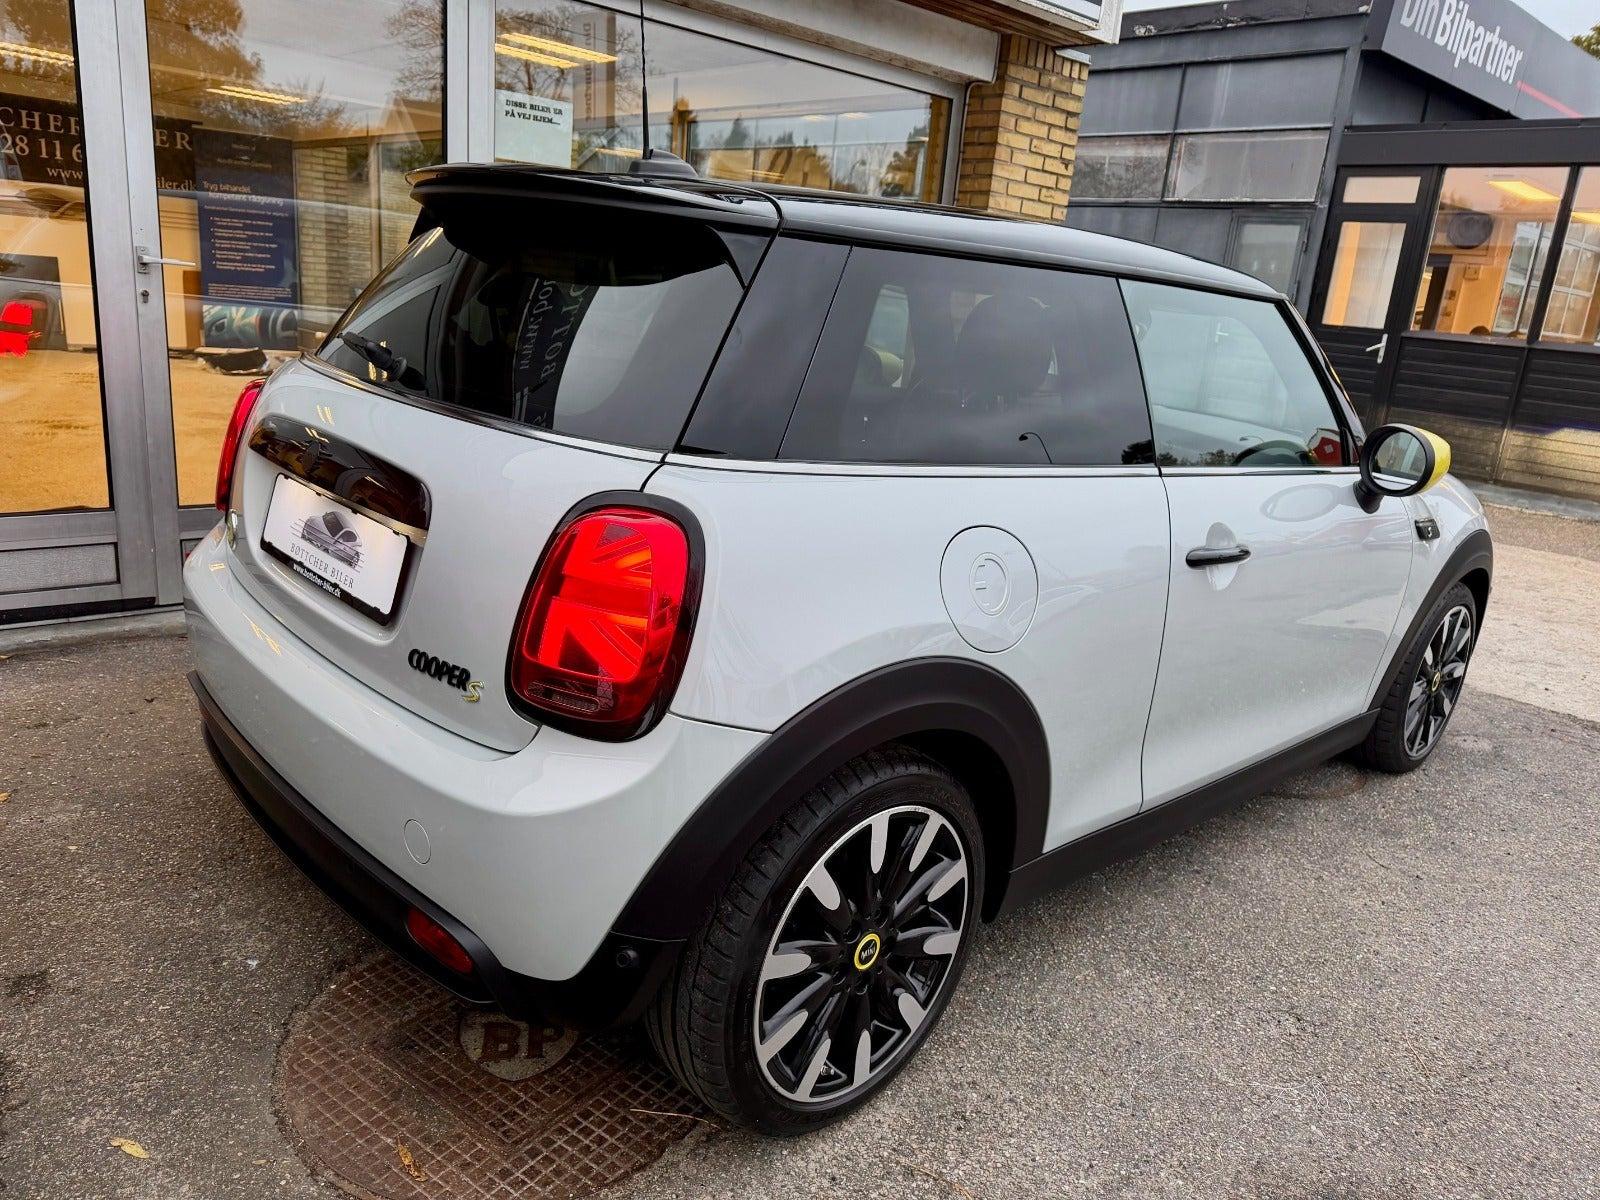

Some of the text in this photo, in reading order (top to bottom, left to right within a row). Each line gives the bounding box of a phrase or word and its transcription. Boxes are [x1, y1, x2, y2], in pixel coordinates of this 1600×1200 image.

[1434, 0, 1523, 84] Bilpartner
[505, 99, 527, 109] DISSE
[529, 103, 551, 114] BILER
[505, 109, 516, 118] PÅ
[517, 112, 531, 120] VEJ
[0, 132, 30, 156] 28
[39, 138, 64, 160] 11
[330, 567, 354, 589] BILER
[408, 648, 484, 703] COOPER S
[481, 1020, 564, 1061] BP
